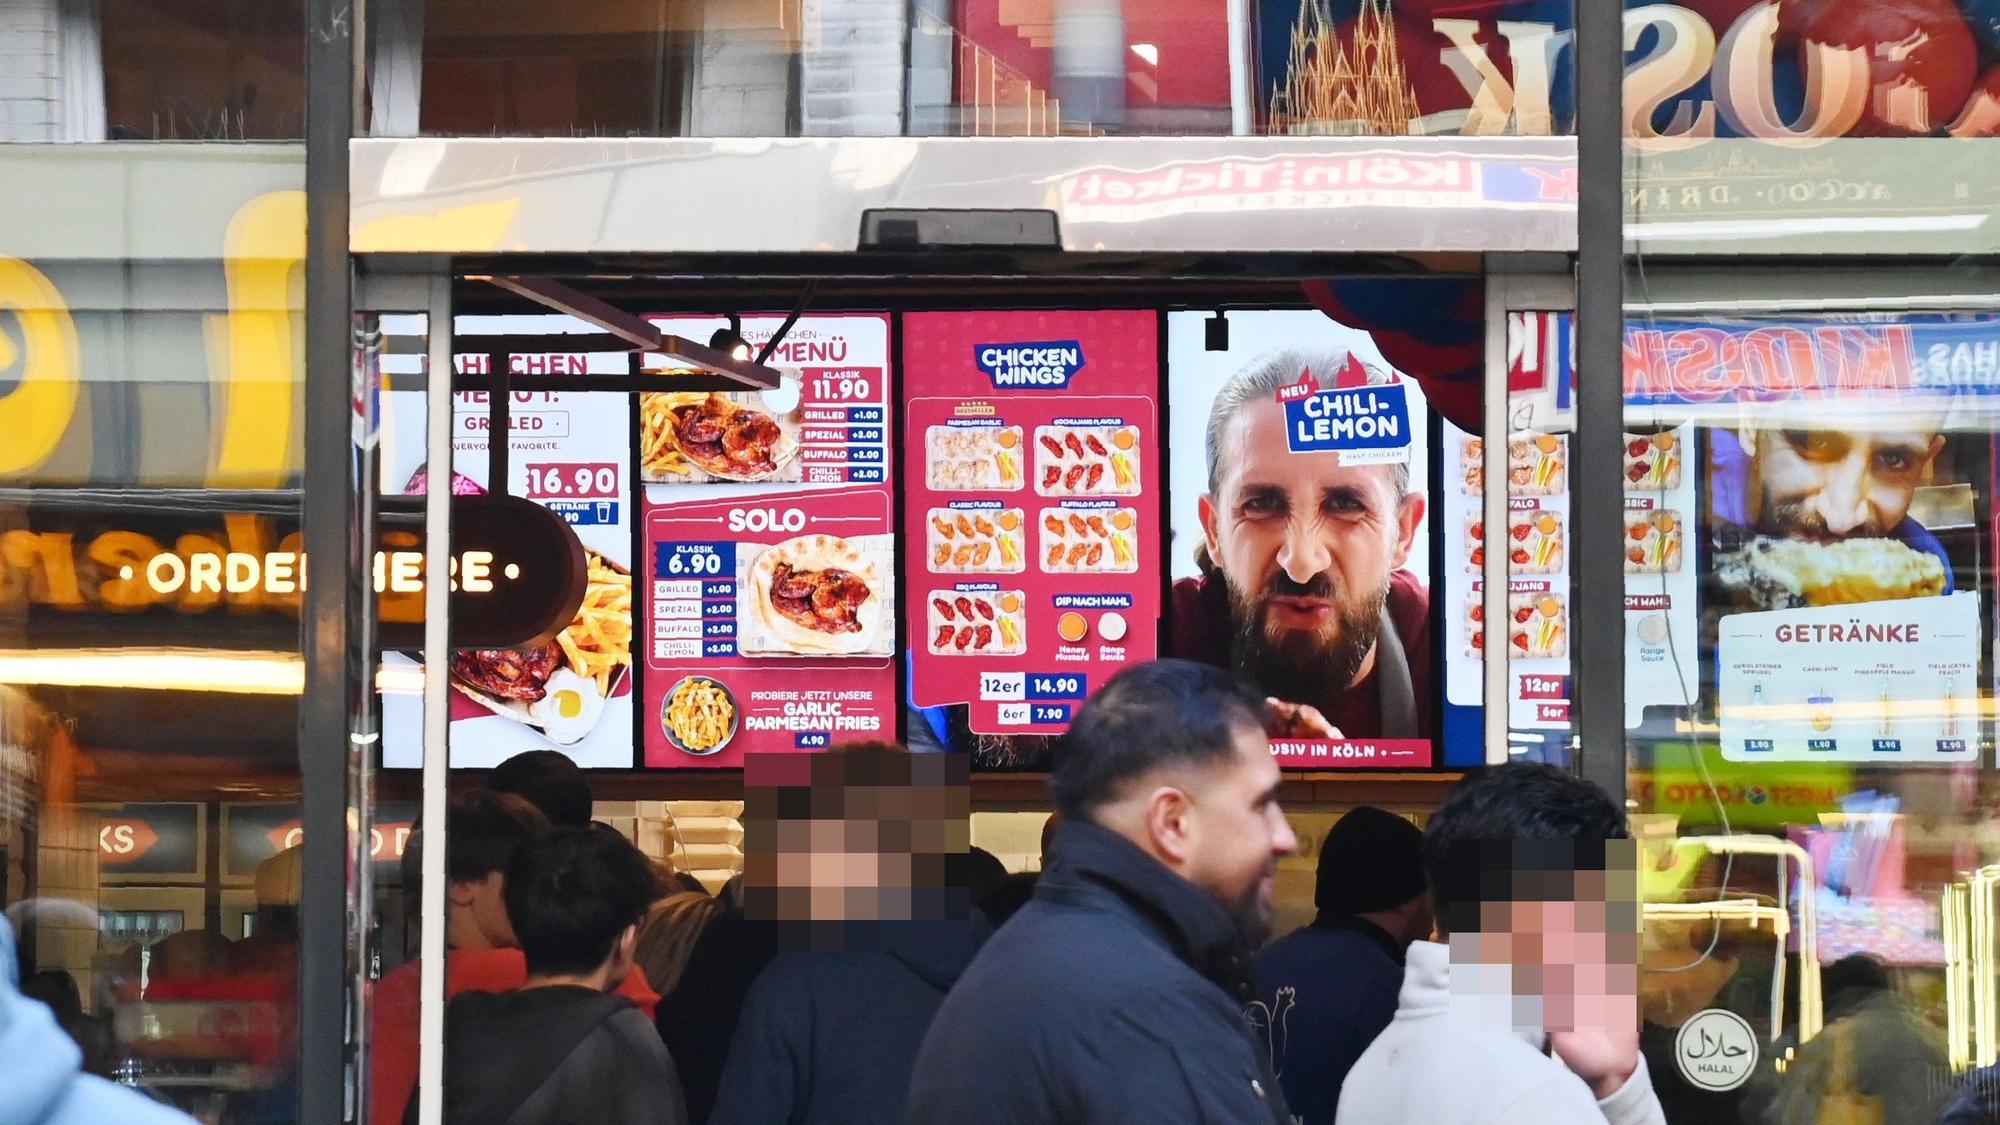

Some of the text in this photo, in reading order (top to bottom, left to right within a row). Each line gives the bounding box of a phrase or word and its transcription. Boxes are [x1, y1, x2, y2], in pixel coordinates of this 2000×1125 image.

[982, 348, 1077, 368] CHICKEN
[823, 371, 860, 379] KLASSIK
[996, 366, 1065, 384] WINGS
[813, 379, 869, 399] 11.90
[1280, 384, 1309, 398] NEU
[1304, 392, 1390, 418] CHILI-
[804, 411, 878, 419] GRILLED +1.00
[1298, 415, 1398, 442] LEMON
[805, 431, 878, 439] SPEZIAL +2.00
[803, 450, 879, 459] BUFFALO +2.00
[809, 467, 841, 475] CHILLI-
[530, 468, 615, 494] 16.90
[728, 508, 806, 532] SOLO
[676, 545, 714, 553] KLASSIK
[668, 553, 721, 573] 6.90
[147, 552, 307, 593] ORDE
[707, 585, 731, 594] +1.00
[1055, 596, 1130, 606] DIP NACH WAHL
[1640, 597, 1669, 606] WAH
[706, 605, 732, 614] +2.00
[707, 625, 733, 634] +2.00
[1775, 619, 1919, 642] GETRÄNKE
[1058, 646, 1086, 656] Honey
[1640, 648, 1665, 656] Range
[1055, 653, 1090, 661] Mustard
[984, 678, 1078, 693] 12er 14.90
[1525, 678, 1559, 692] 12er
[751, 691, 873, 700] PROBIERE JETZT UNSERE
[784, 702, 841, 716] GARLIC
[1003, 708, 1063, 719] 6er 7.90
[1542, 707, 1563, 717] 6er
[745, 716, 880, 730] PARMESAN FRIES
[801, 736, 824, 745] 4.90
[1311, 744, 1327, 756] IN
[1332, 742, 1375, 757] KÖLN
[1687, 1027, 1747, 1059] حلال
[1698, 1064, 1735, 1074] HALAL
